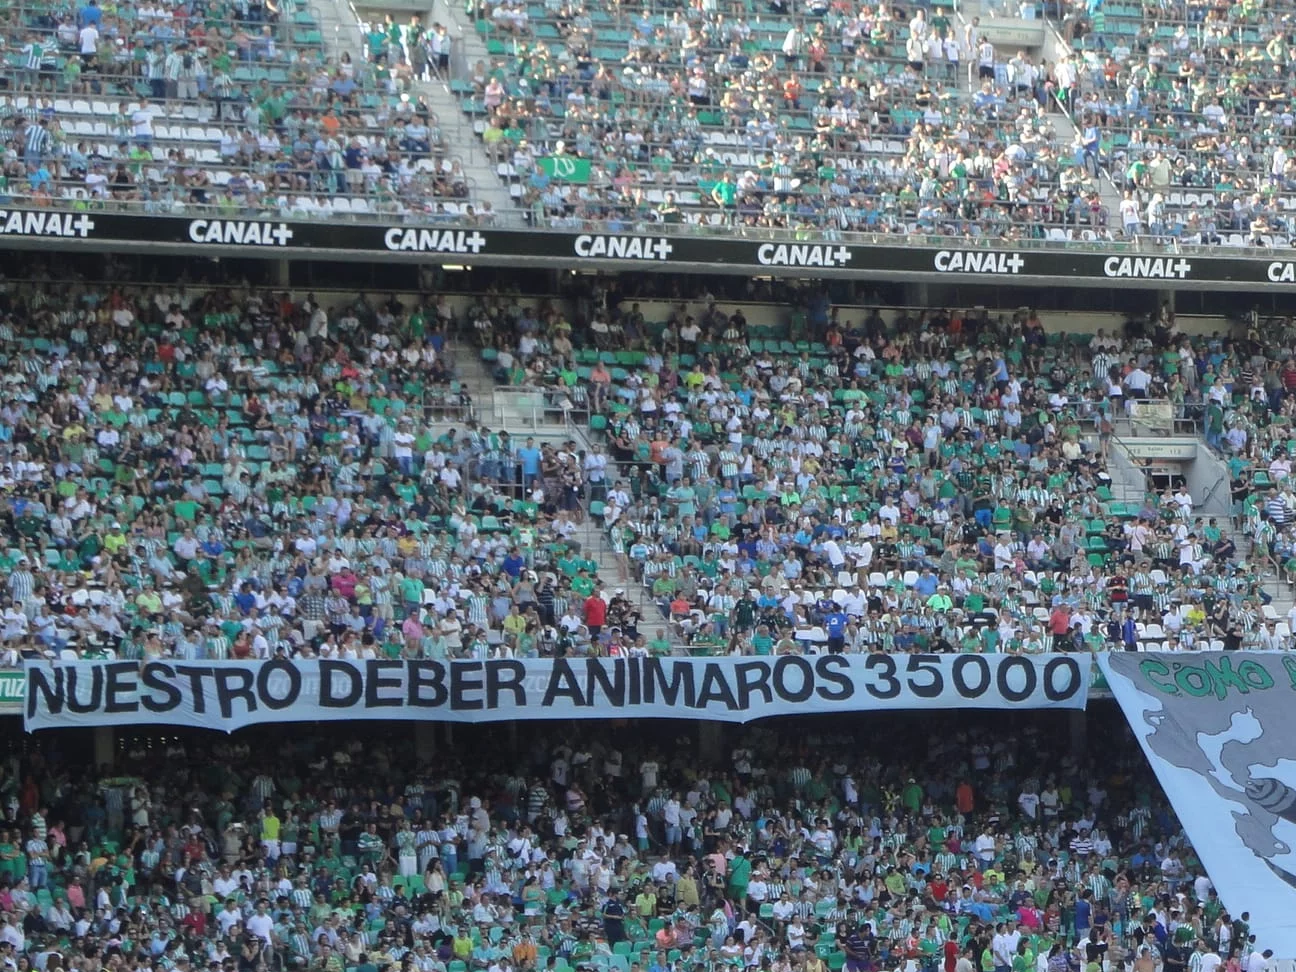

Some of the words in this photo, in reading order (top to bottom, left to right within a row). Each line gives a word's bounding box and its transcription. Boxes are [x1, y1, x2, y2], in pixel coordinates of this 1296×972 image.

[189, 219, 293, 245] CANAL+
[385, 228, 486, 254] CANAL+
[575, 234, 673, 260] CANAL+
[757, 243, 852, 268] CANAL+
[934, 250, 1025, 274] CANAL+
[1104, 256, 1191, 280] CANAL+
[28, 659, 300, 719] NUESTRO
[318, 658, 527, 711] DEBER
[542, 654, 853, 711] ANIMAROS
[865, 653, 1082, 701] 35000
[1139, 659, 1274, 700] COMO
